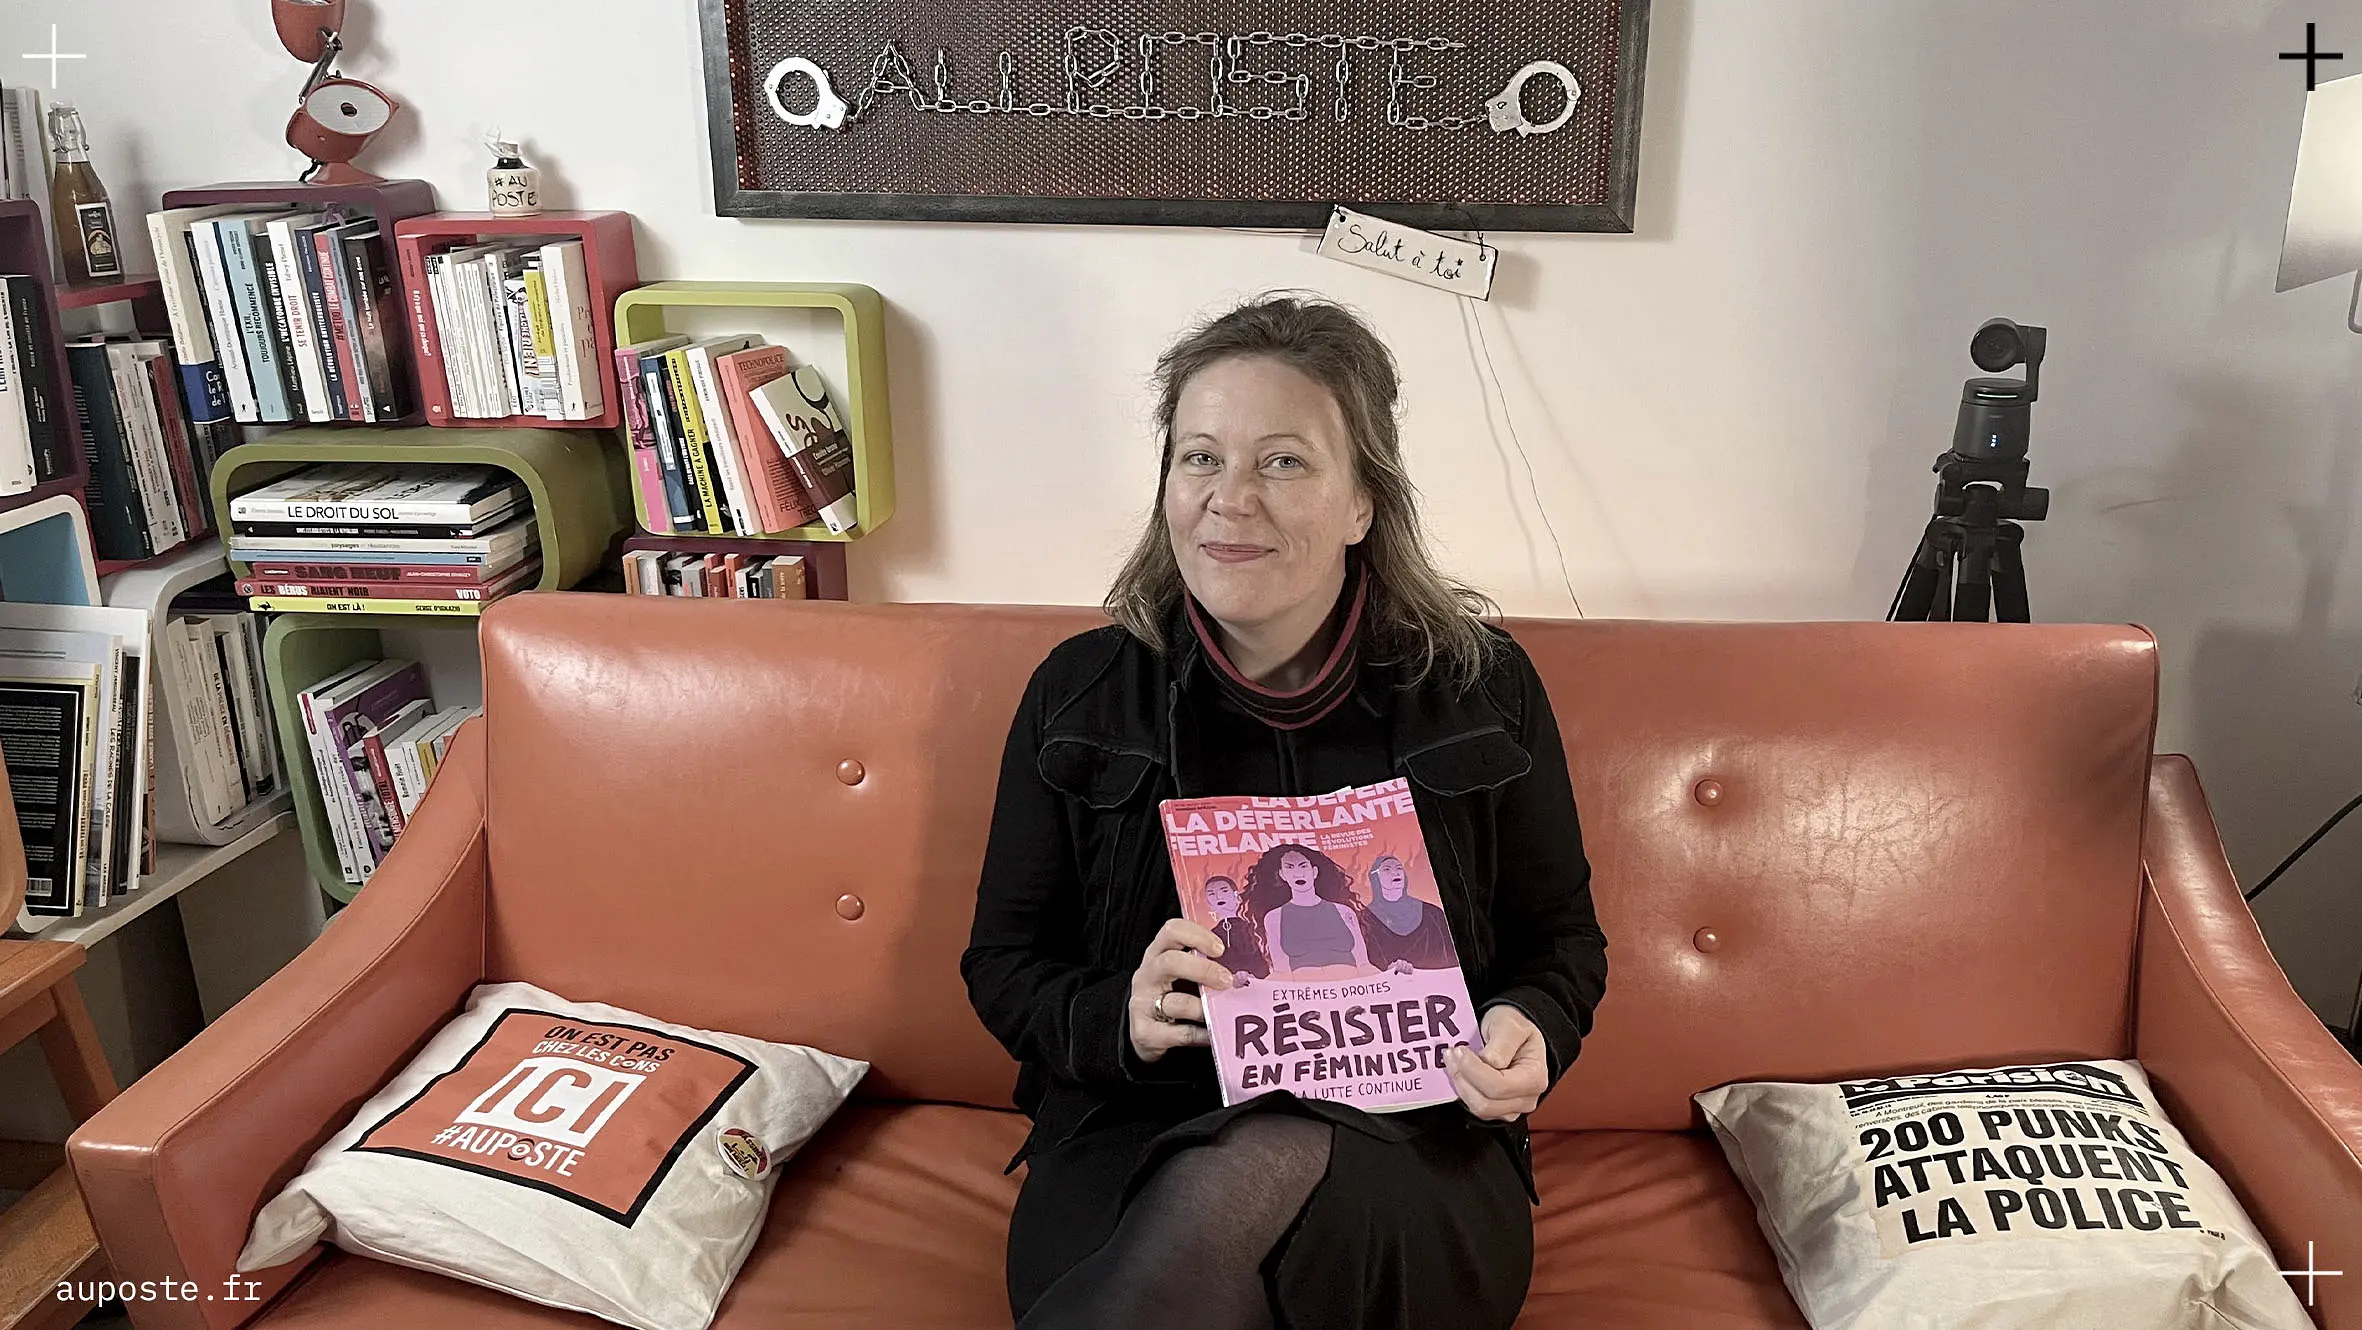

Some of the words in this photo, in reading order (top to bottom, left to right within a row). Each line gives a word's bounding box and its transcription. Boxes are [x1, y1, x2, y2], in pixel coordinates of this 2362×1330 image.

[492, 190, 536, 207] POSTE
[1338, 224, 1405, 262] Salut
[1412, 250, 1424, 268] à
[265, 262, 282, 296] INVISIBLE
[287, 294, 301, 315] DROIT
[291, 316, 305, 337] TENIR
[255, 332, 271, 363] TOUJOURS
[298, 338, 307, 347] SE
[737, 353, 784, 372] TECHNOPOLICE
[688, 428, 702, 457] GAGNER
[697, 464, 711, 497] MACHINE
[288, 506, 302, 518] LE
[306, 507, 347, 518] DROIT
[350, 507, 369, 519] DU
[372, 507, 399, 520] SOL
[704, 497, 713, 508] LA
[260, 585, 275, 594] LES
[277, 583, 308, 595] BÉRUS
[310, 586, 344, 596] RIAIENT
[347, 586, 369, 596] NOIR
[352, 602, 362, 611] LÀ
[213, 672, 219, 680] DE
[215, 683, 221, 692] LA
[107, 744, 116, 778] RACINES
[106, 791, 112, 800] LA
[1166, 813, 1210, 833] LA
[1213, 791, 1415, 832] DÉFERLANTE
[1322, 833, 1374, 846] RÉVOLUTIONS
[1322, 840, 1368, 851] FÉMINISTES
[1272, 987, 1338, 1001] EXTRÊMES
[1341, 981, 1391, 998] DROITES
[1235, 995, 1460, 1059] RÉSISTER
[532, 1040, 578, 1056] CHEZ
[576, 1047, 611, 1063] LES
[543, 1026, 577, 1041] ON
[581, 1032, 630, 1051] EST
[626, 1041, 675, 1062] PAS
[1241, 1063, 1283, 1089] EN
[1294, 1041, 1469, 1082] FÉMINISTE
[1314, 1085, 1352, 1100] LUTTE
[1358, 1078, 1423, 1095] CONTINUE
[1895, 1067, 2126, 1096] Parisien
[474, 1065, 630, 1136] ICI
[1905, 1111, 1920, 1119] des
[1921, 1105, 1955, 1115] cabines
[1859, 1110, 1965, 1162] 200
[1978, 1107, 2163, 1156] PUNKS
[432, 1124, 585, 1177] #AUPOSTE
[1874, 1143, 2190, 1208] ATTAQUENT
[1901, 1196, 1977, 1244] LA
[1984, 1187, 2202, 1232] POLICE
